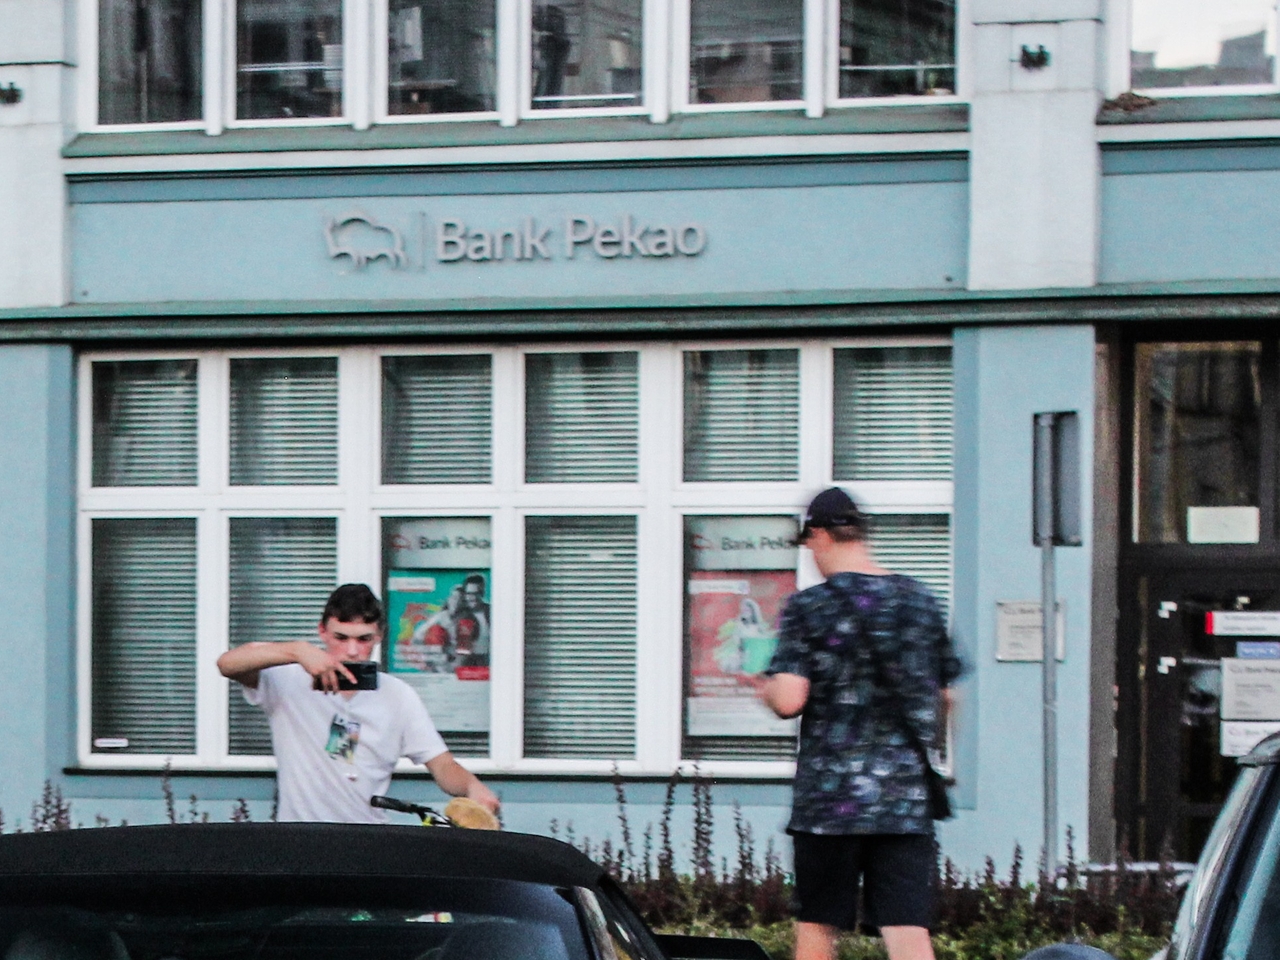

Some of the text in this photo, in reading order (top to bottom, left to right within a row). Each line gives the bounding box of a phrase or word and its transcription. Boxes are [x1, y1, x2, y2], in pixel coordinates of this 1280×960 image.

[437, 213, 707, 262] Bank Pekao
[419, 535, 450, 550] Bank
